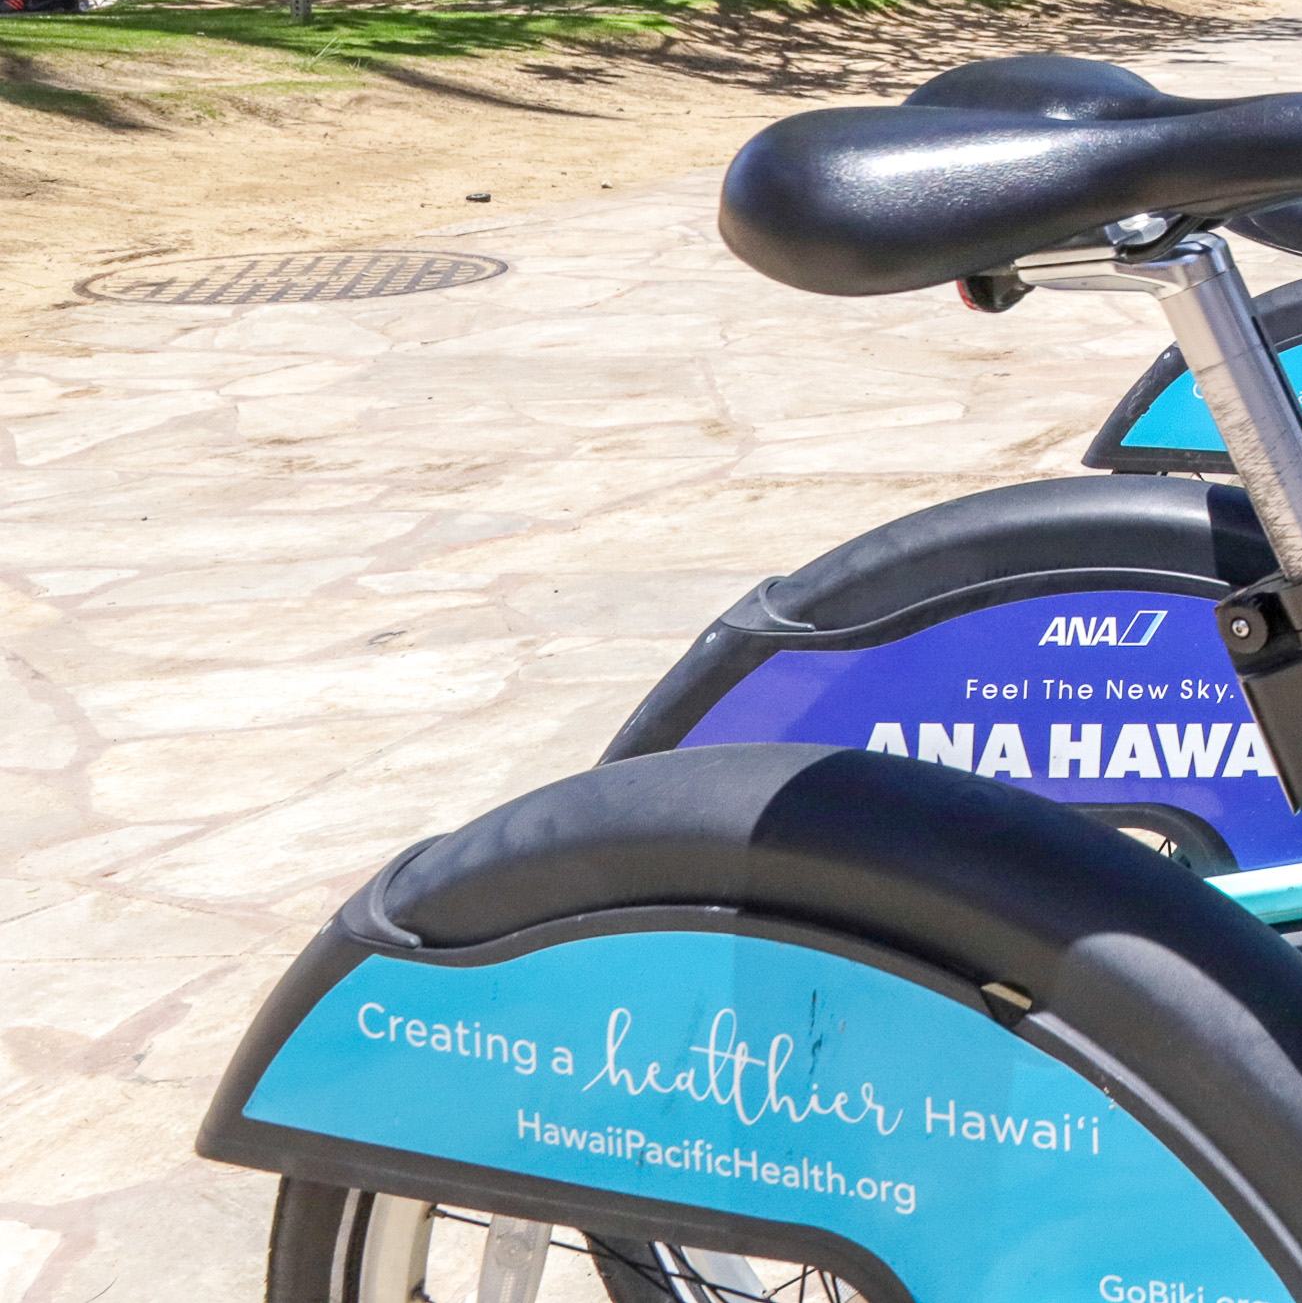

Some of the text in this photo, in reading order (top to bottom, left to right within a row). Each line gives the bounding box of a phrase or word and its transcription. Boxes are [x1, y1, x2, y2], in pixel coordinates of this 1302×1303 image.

[1038, 617, 1119, 646] ANA
[965, 679, 1235, 704] Feel The New Sky.
[865, 722, 1033, 778] ANA
[357, 1001, 538, 1076] Creating
[550, 1042, 575, 1077] a
[582, 1007, 903, 1136] healthier
[516, 1108, 917, 1215] HawaiiPacificHealth.org
